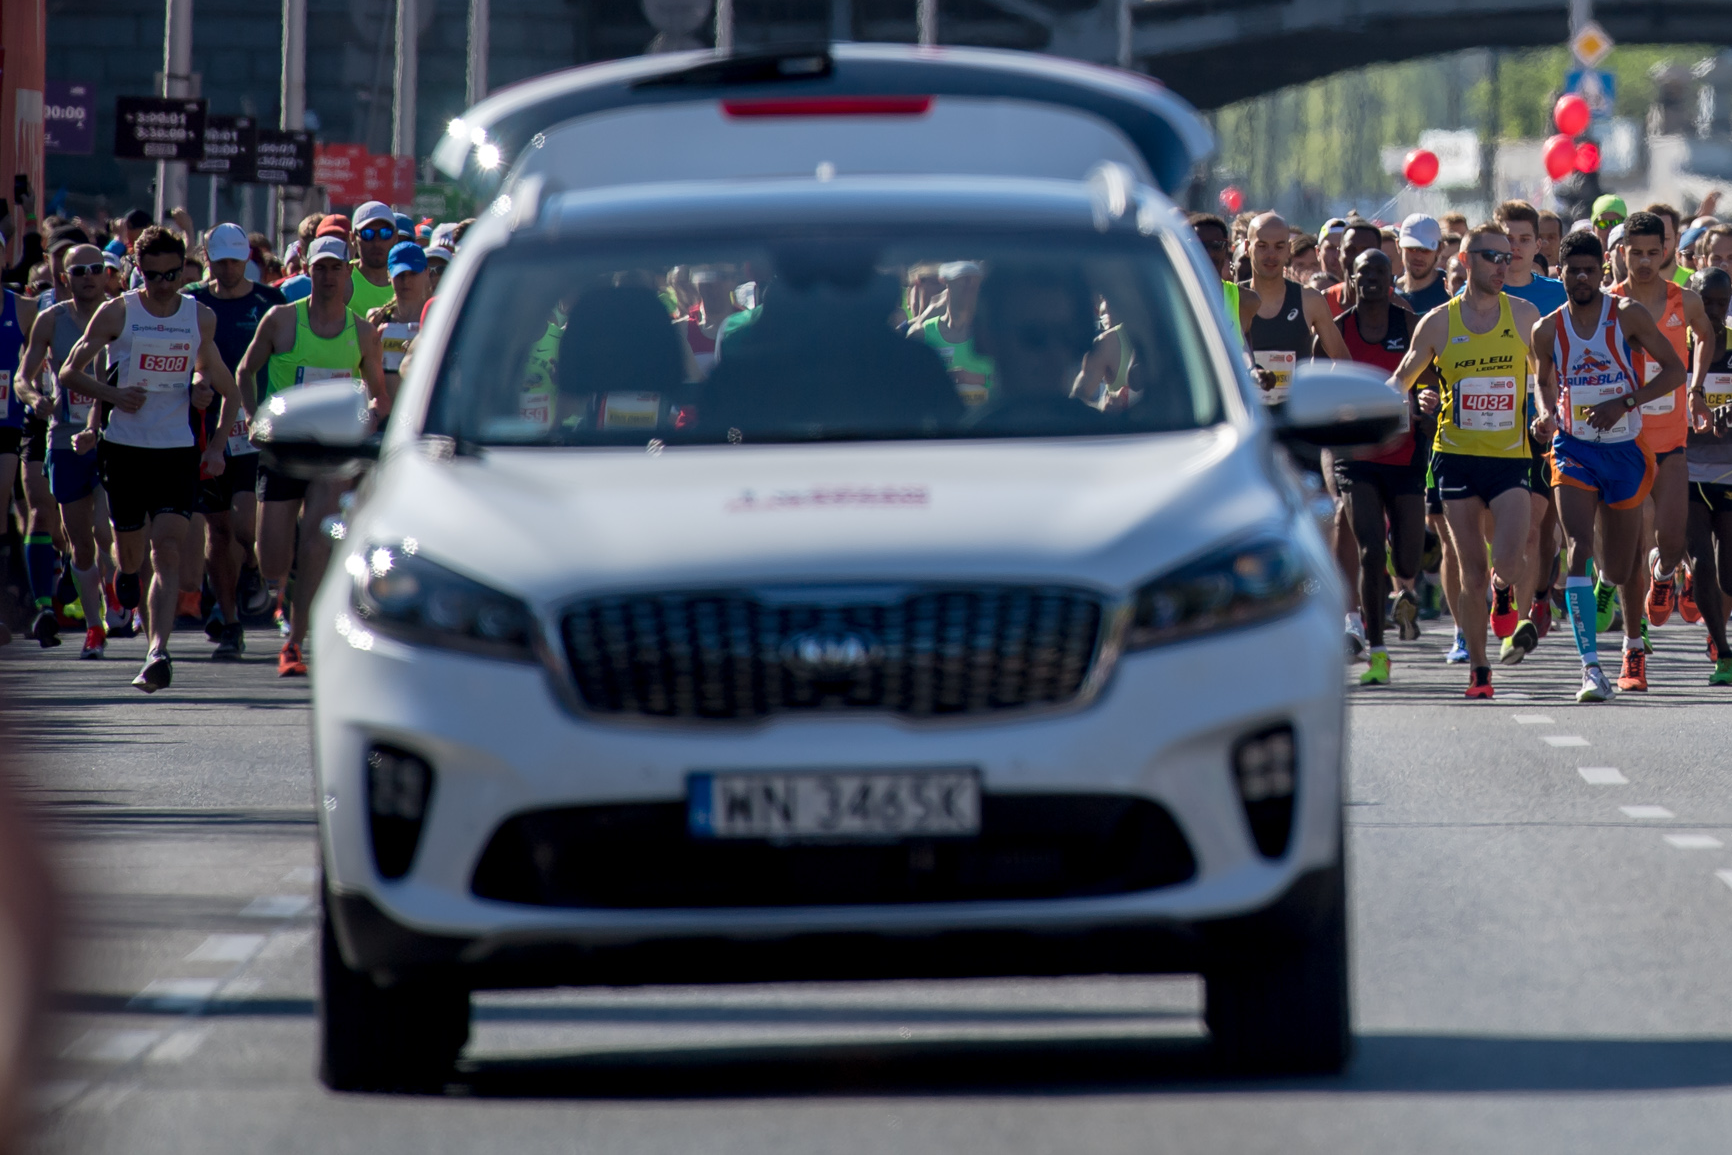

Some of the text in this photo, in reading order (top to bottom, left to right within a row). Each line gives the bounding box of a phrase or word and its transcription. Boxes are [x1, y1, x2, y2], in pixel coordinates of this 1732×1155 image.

[144, 356, 185, 372] 6308
[1454, 355, 1513, 369] KB LEW
[1466, 395, 1510, 410] 4032
